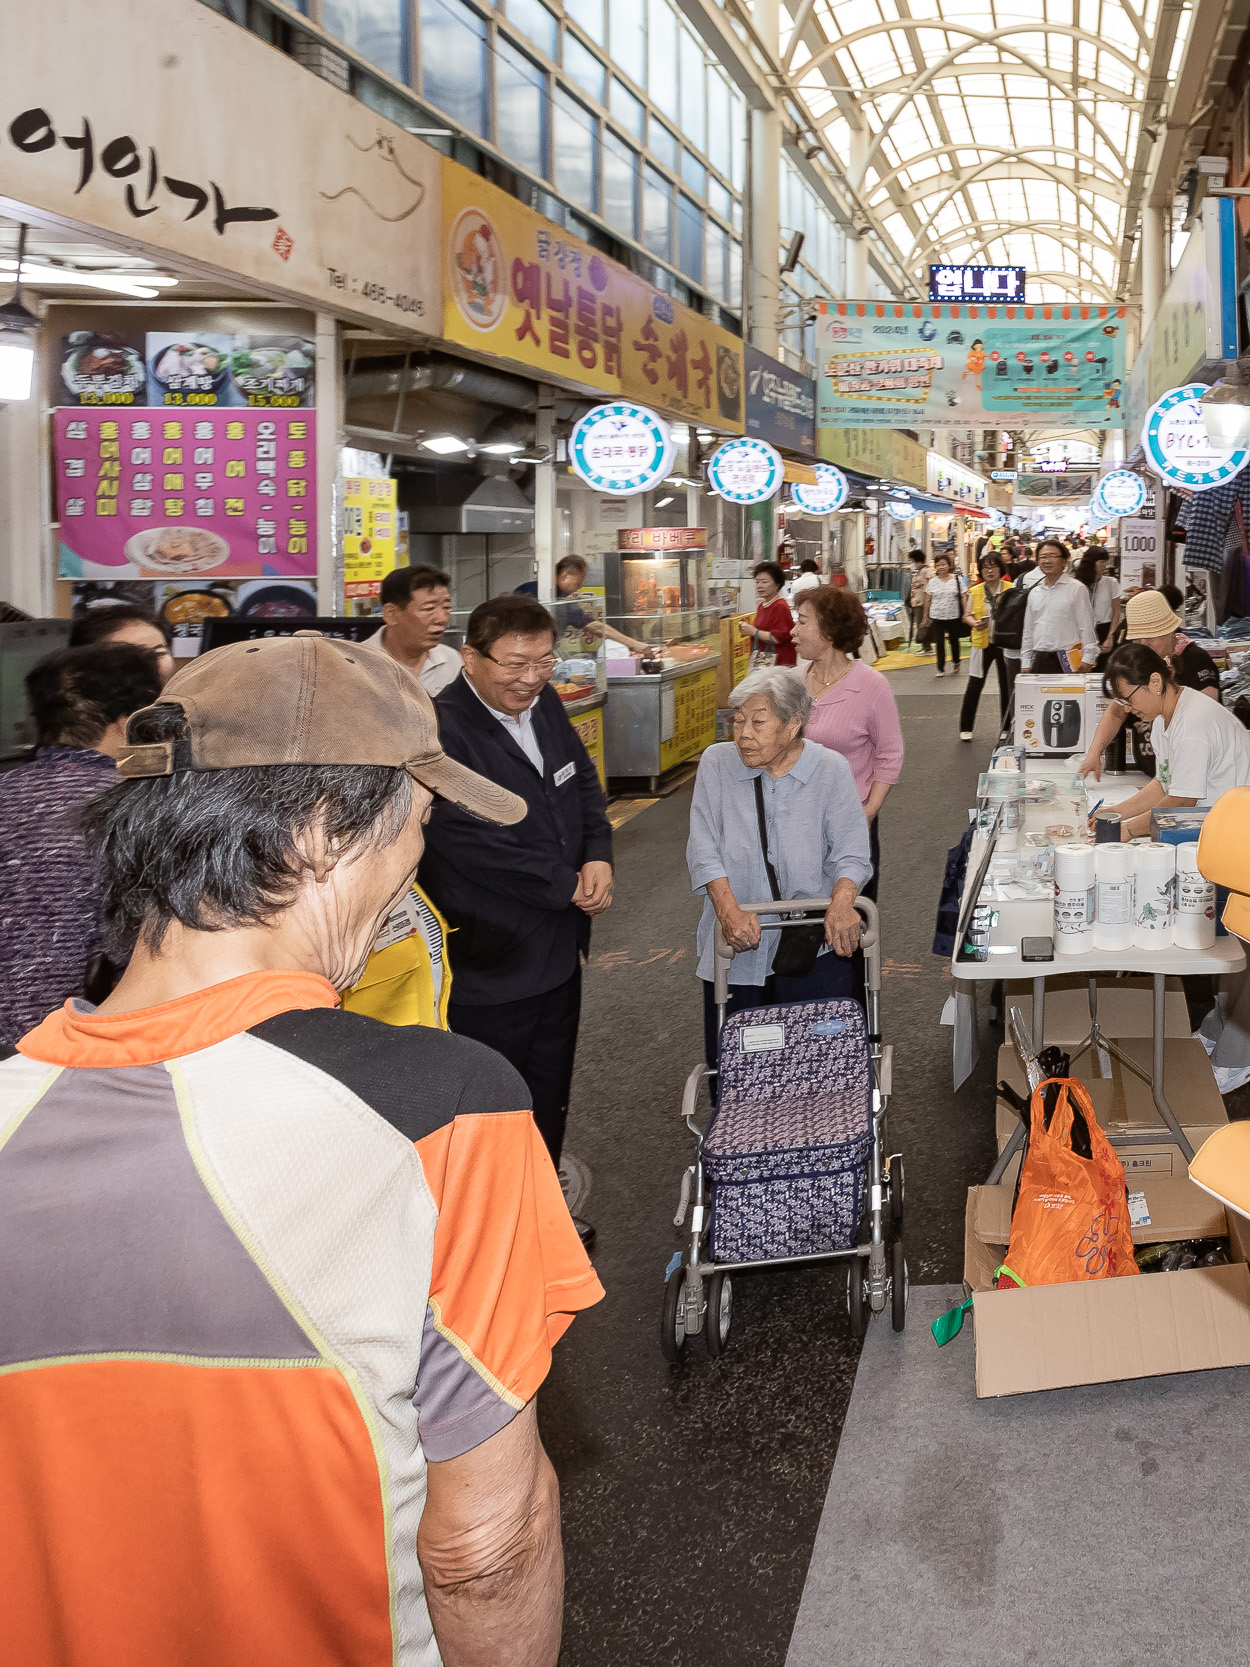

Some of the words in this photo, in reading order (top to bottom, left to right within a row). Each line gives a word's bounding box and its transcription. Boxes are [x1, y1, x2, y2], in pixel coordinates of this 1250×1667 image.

[9, 107, 280, 236] 어인가
[512, 256, 623, 379] 옛날통닭
[163, 392, 218, 406] 13,000
[247, 394, 300, 407] 15,000
